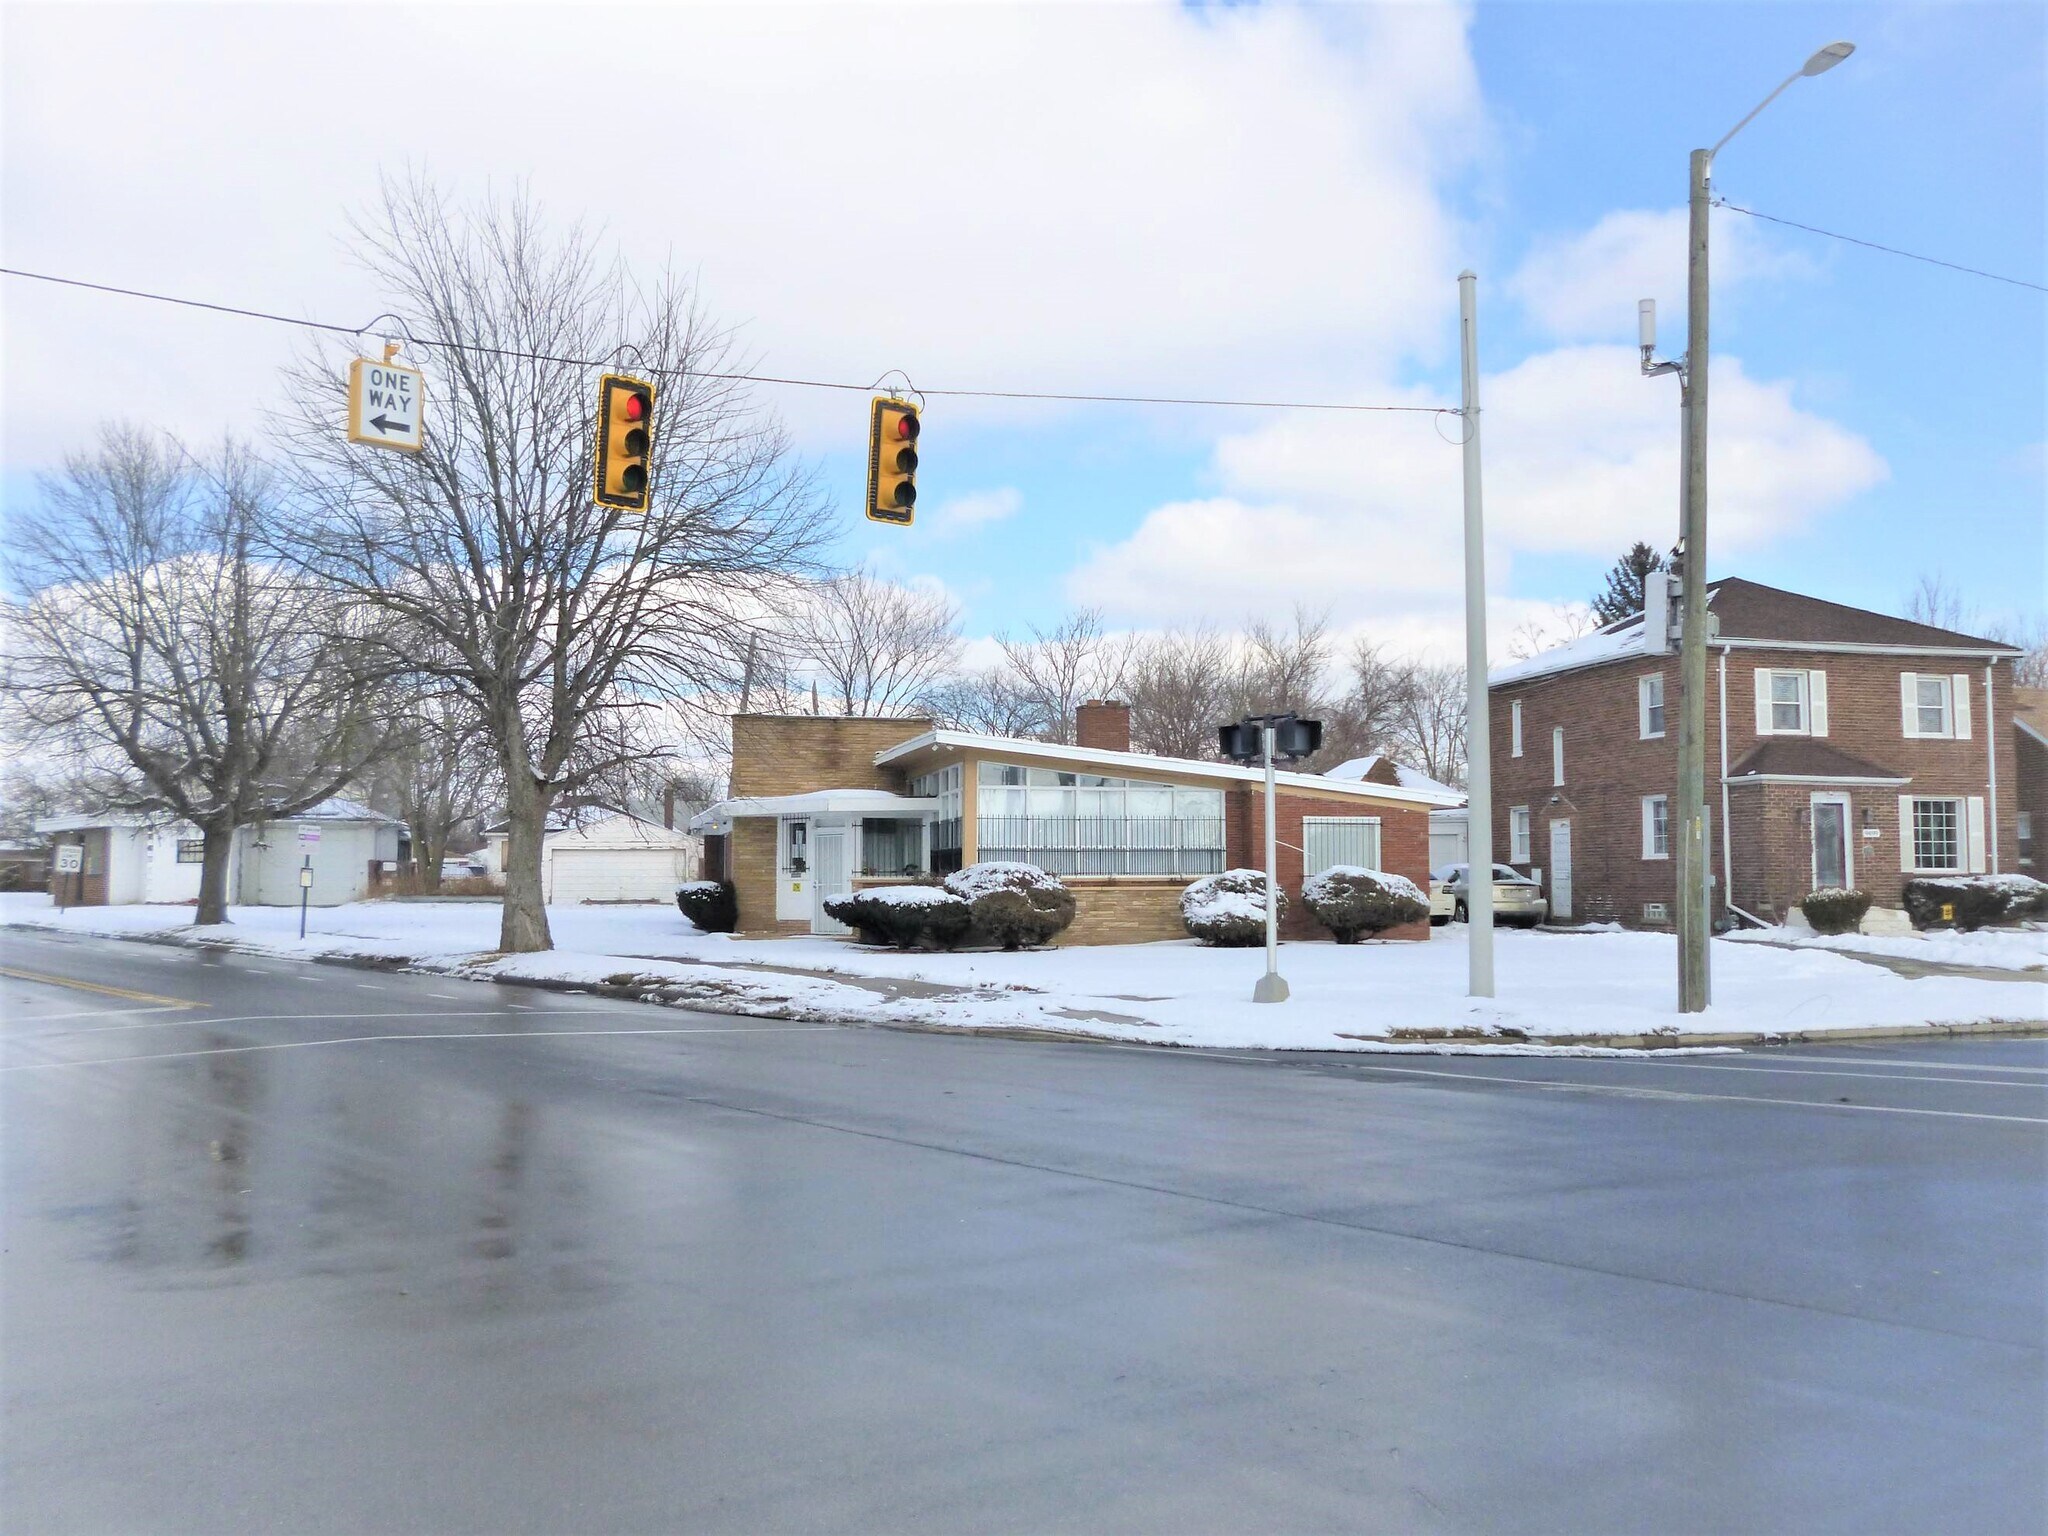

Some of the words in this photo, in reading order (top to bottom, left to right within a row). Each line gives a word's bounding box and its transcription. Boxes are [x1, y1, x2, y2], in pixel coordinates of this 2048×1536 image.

[371, 369, 410, 393] ONE
[369, 389, 411, 413] WAY
[60, 858, 78, 869] 30
